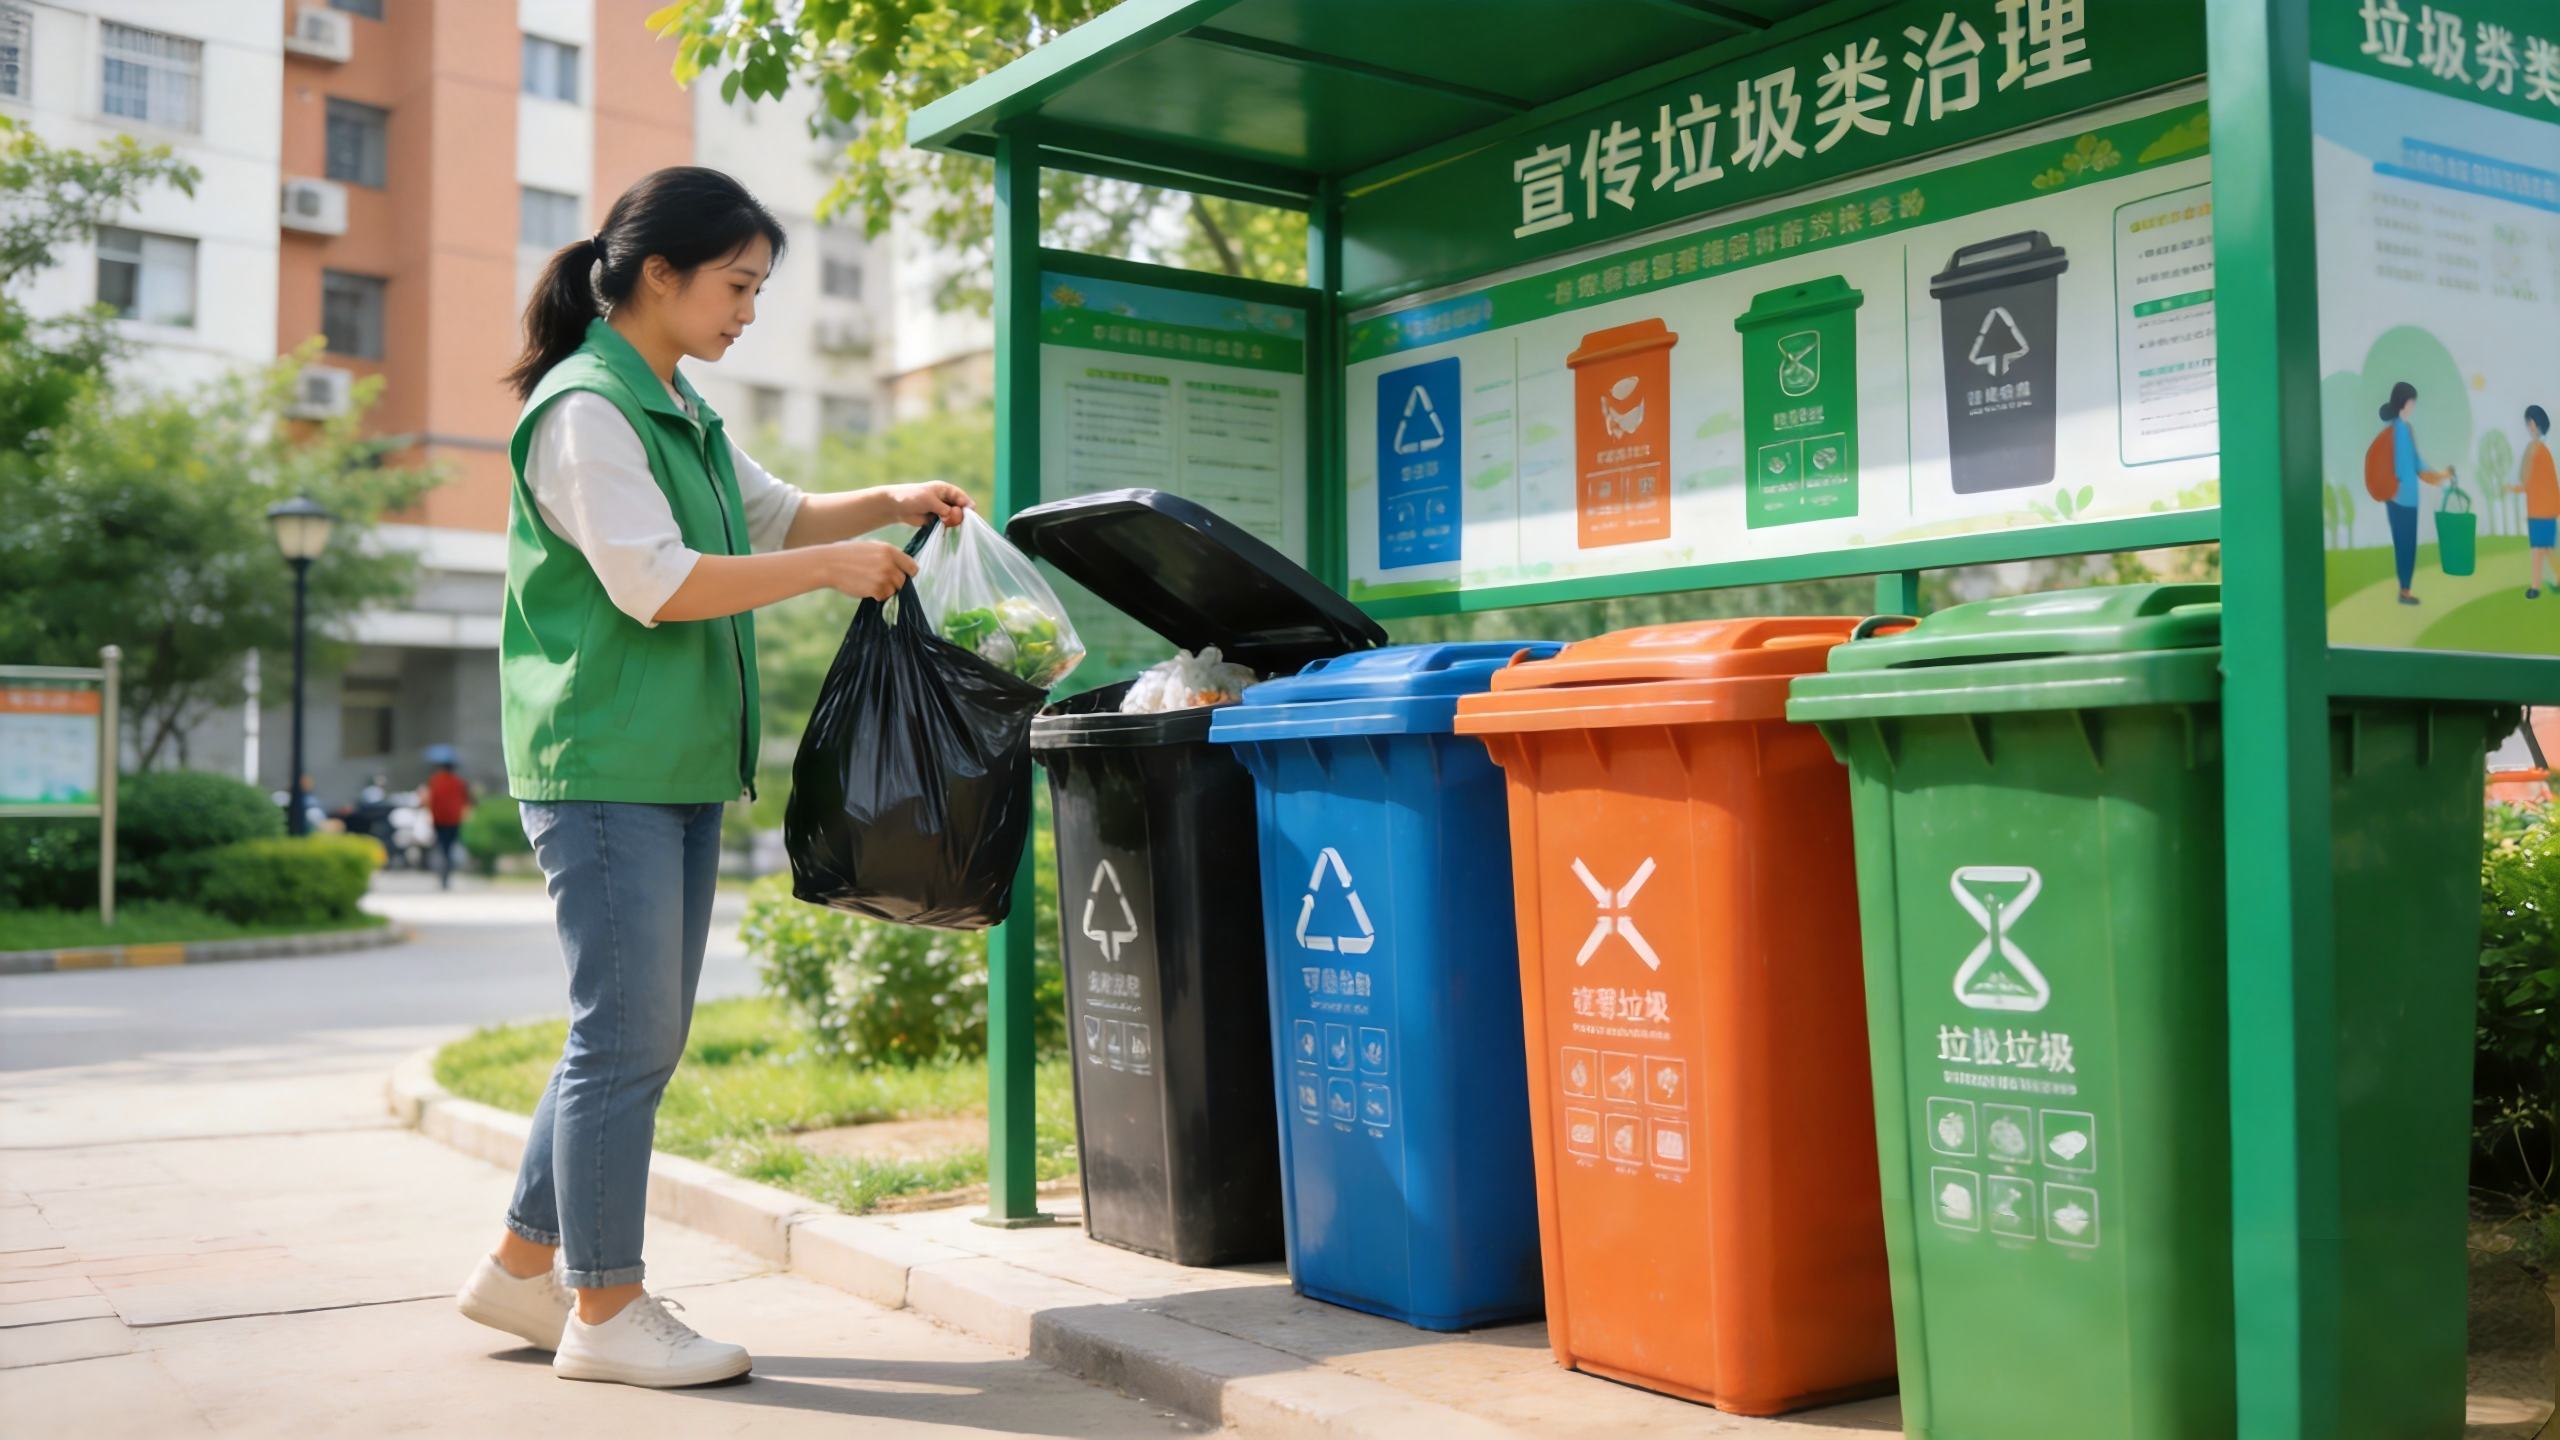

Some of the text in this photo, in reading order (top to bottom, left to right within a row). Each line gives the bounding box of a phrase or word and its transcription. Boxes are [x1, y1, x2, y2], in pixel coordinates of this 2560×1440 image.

[1513, 0, 2093, 238] 宣传垃圾类治理
